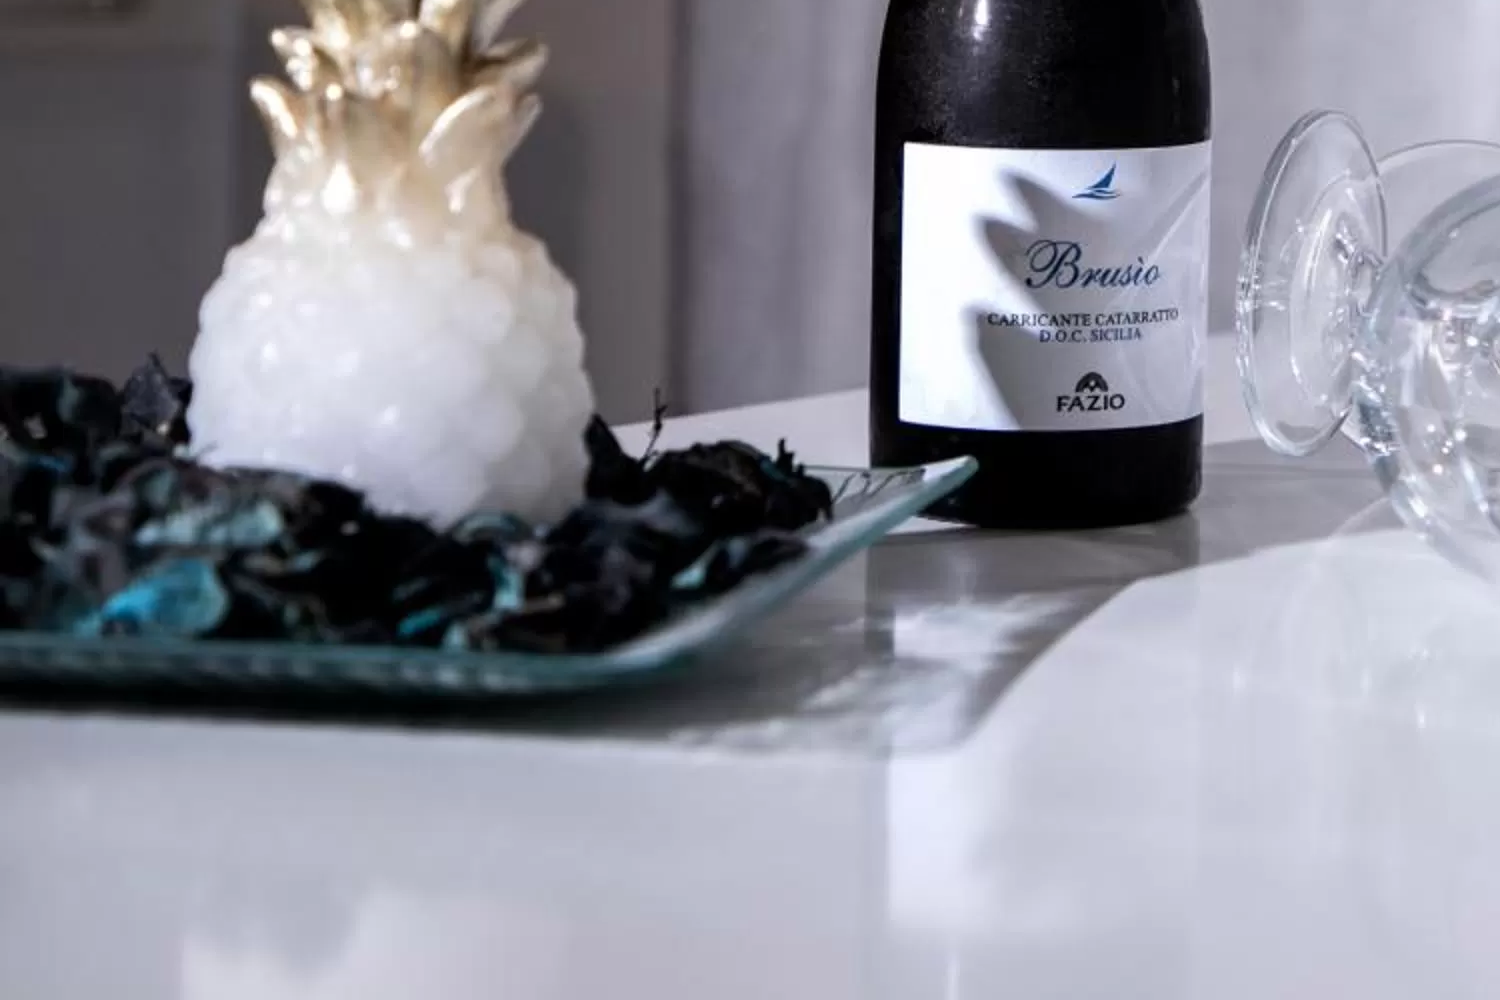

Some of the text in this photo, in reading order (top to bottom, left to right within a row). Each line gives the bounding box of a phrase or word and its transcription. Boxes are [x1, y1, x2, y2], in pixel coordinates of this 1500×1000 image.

[987, 308, 1179, 328] CARRICANTE CATARRATTO
[1039, 327, 1143, 343] D.O.C. SICILIA
[1056, 393, 1126, 413] FAZIO
